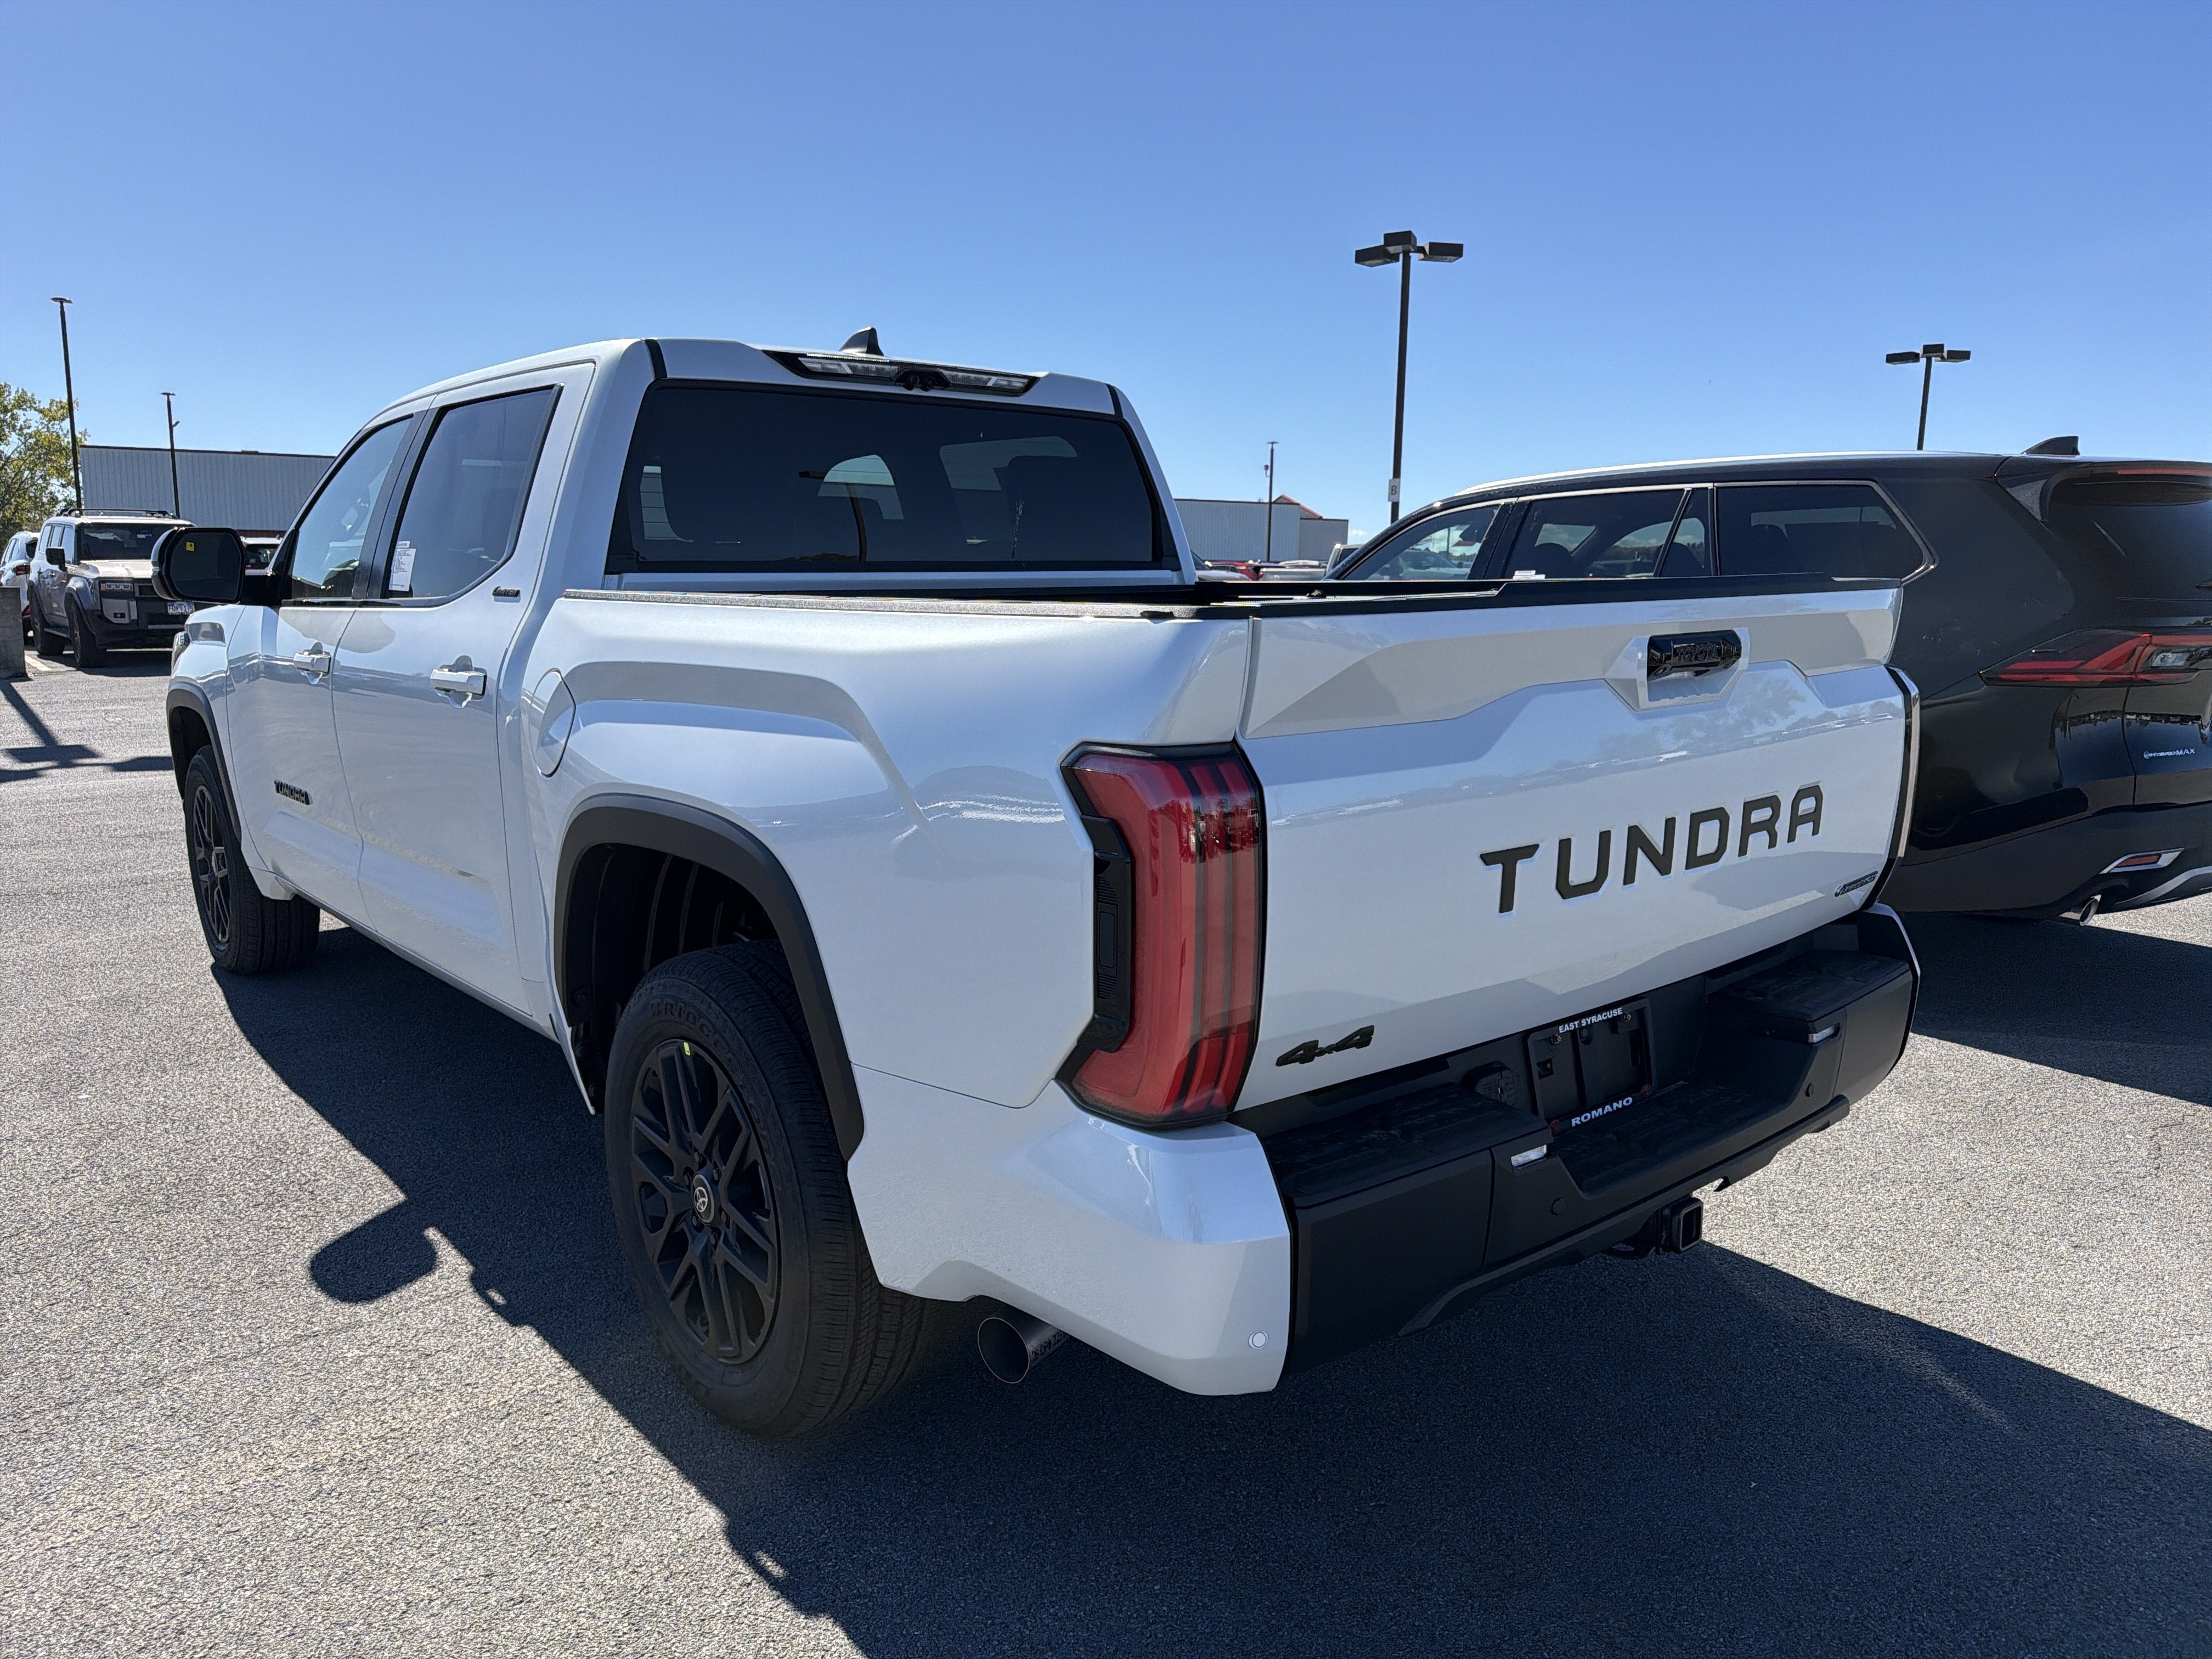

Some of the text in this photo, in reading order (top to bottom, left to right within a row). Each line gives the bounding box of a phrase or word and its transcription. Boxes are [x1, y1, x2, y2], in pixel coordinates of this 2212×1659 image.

[1390, 484, 1397, 495] B
[274, 779, 310, 805] TUNDRA
[1480, 784, 1824, 913] TUNDRA
[1559, 1007, 1623, 1034] EAST SYRACUSE
[1571, 1097, 1633, 1127] ROMANO
